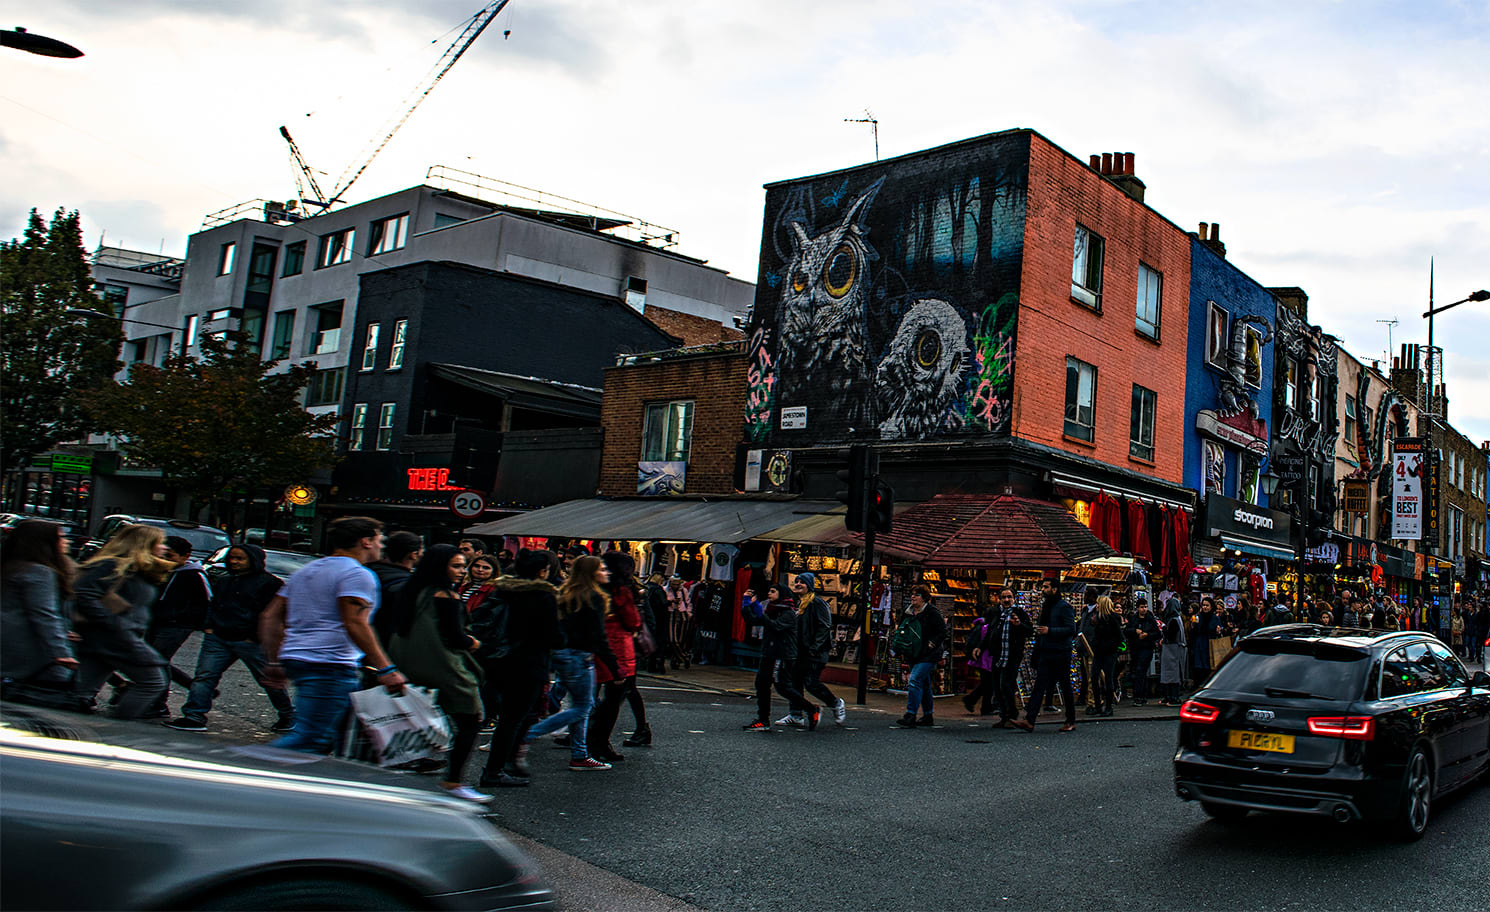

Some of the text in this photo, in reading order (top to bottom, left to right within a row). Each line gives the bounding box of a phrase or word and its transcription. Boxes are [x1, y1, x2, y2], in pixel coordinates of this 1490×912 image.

[1396, 460, 1406, 477] 4
[456, 498, 481, 510] 20
[1396, 502, 1418, 513] BEST
[1233, 508, 1274, 529] scorpion
